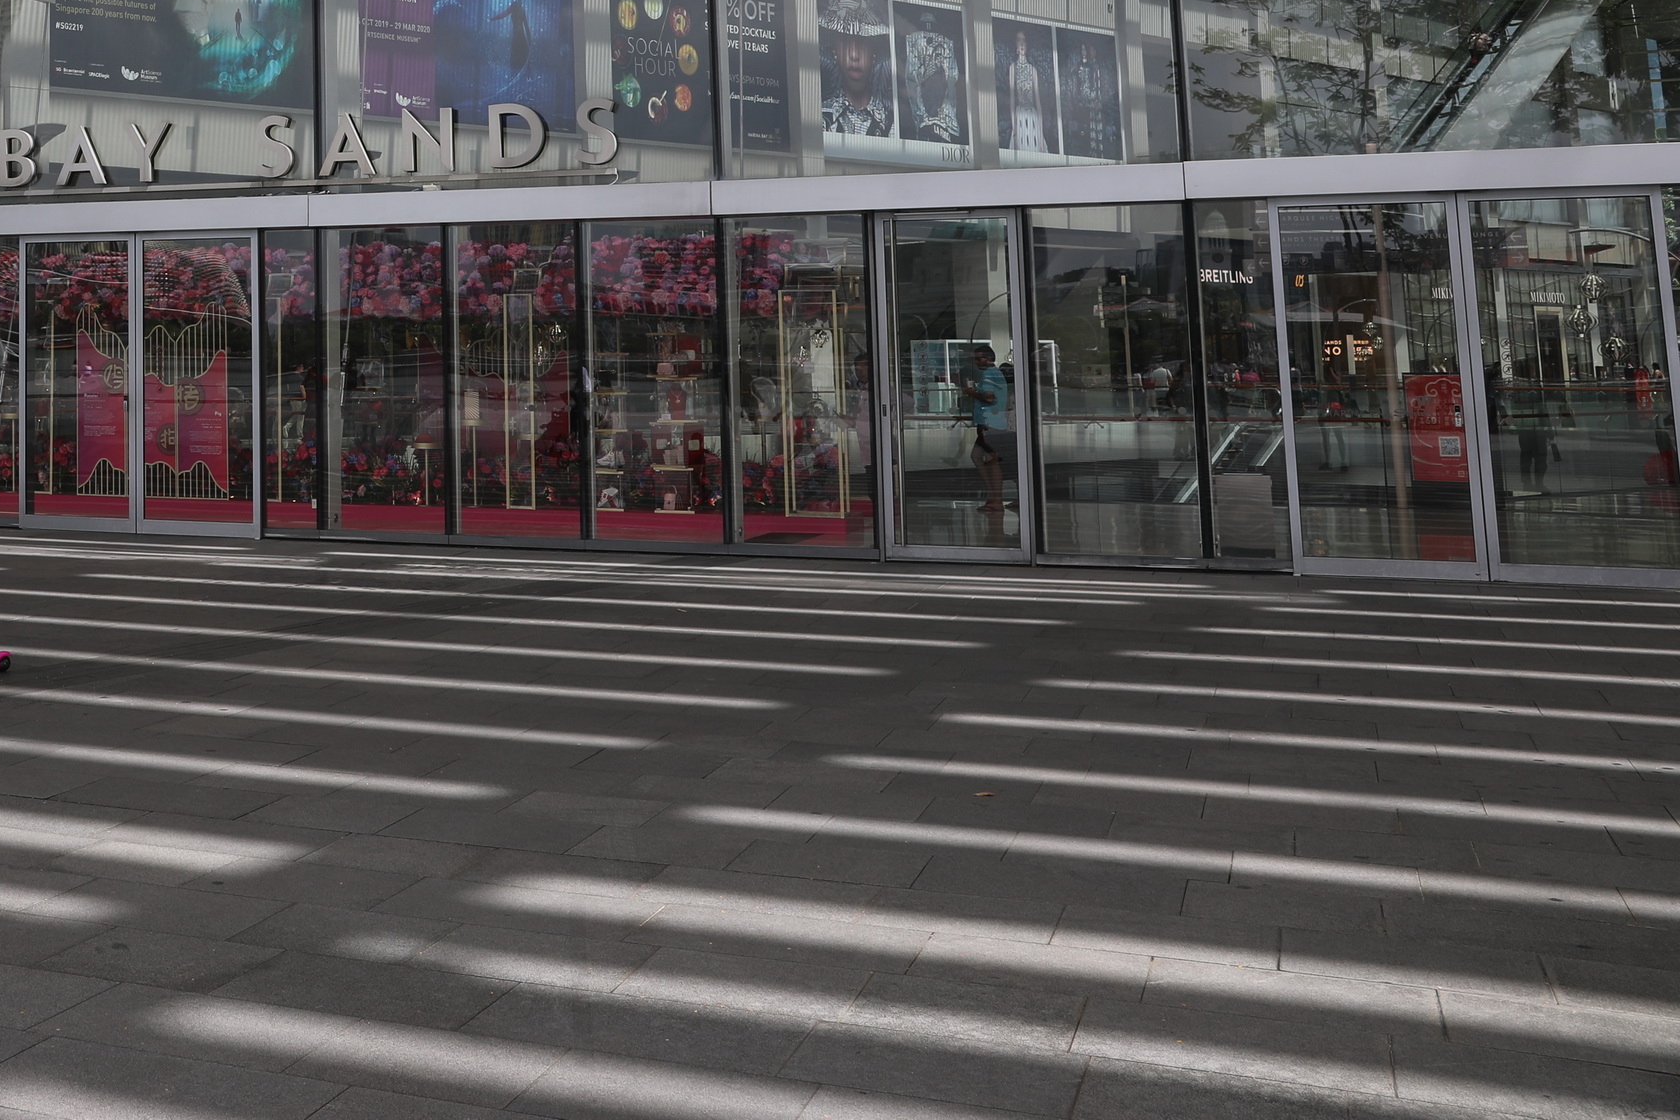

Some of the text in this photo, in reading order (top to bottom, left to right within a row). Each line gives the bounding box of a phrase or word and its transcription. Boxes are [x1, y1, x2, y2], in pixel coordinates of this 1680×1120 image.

[56, 3, 157, 22] Singapore 200 years from now.
[149, 1, 157, 10] of
[745, 0, 776, 23] OFF
[56, 21, 83, 31] #SG2219
[375, 19, 390, 28] 2019
[402, 23, 416, 32] MAR
[627, 36, 681, 60] SOCIAL
[752, 42, 769, 54] BARS
[634, 57, 677, 78] HOUR
[755, 77, 765, 86] TO
[258, 99, 619, 179] SANDS
[942, 146, 971, 164] DIOR
[1530, 291, 1566, 304] MIKIMOTO
